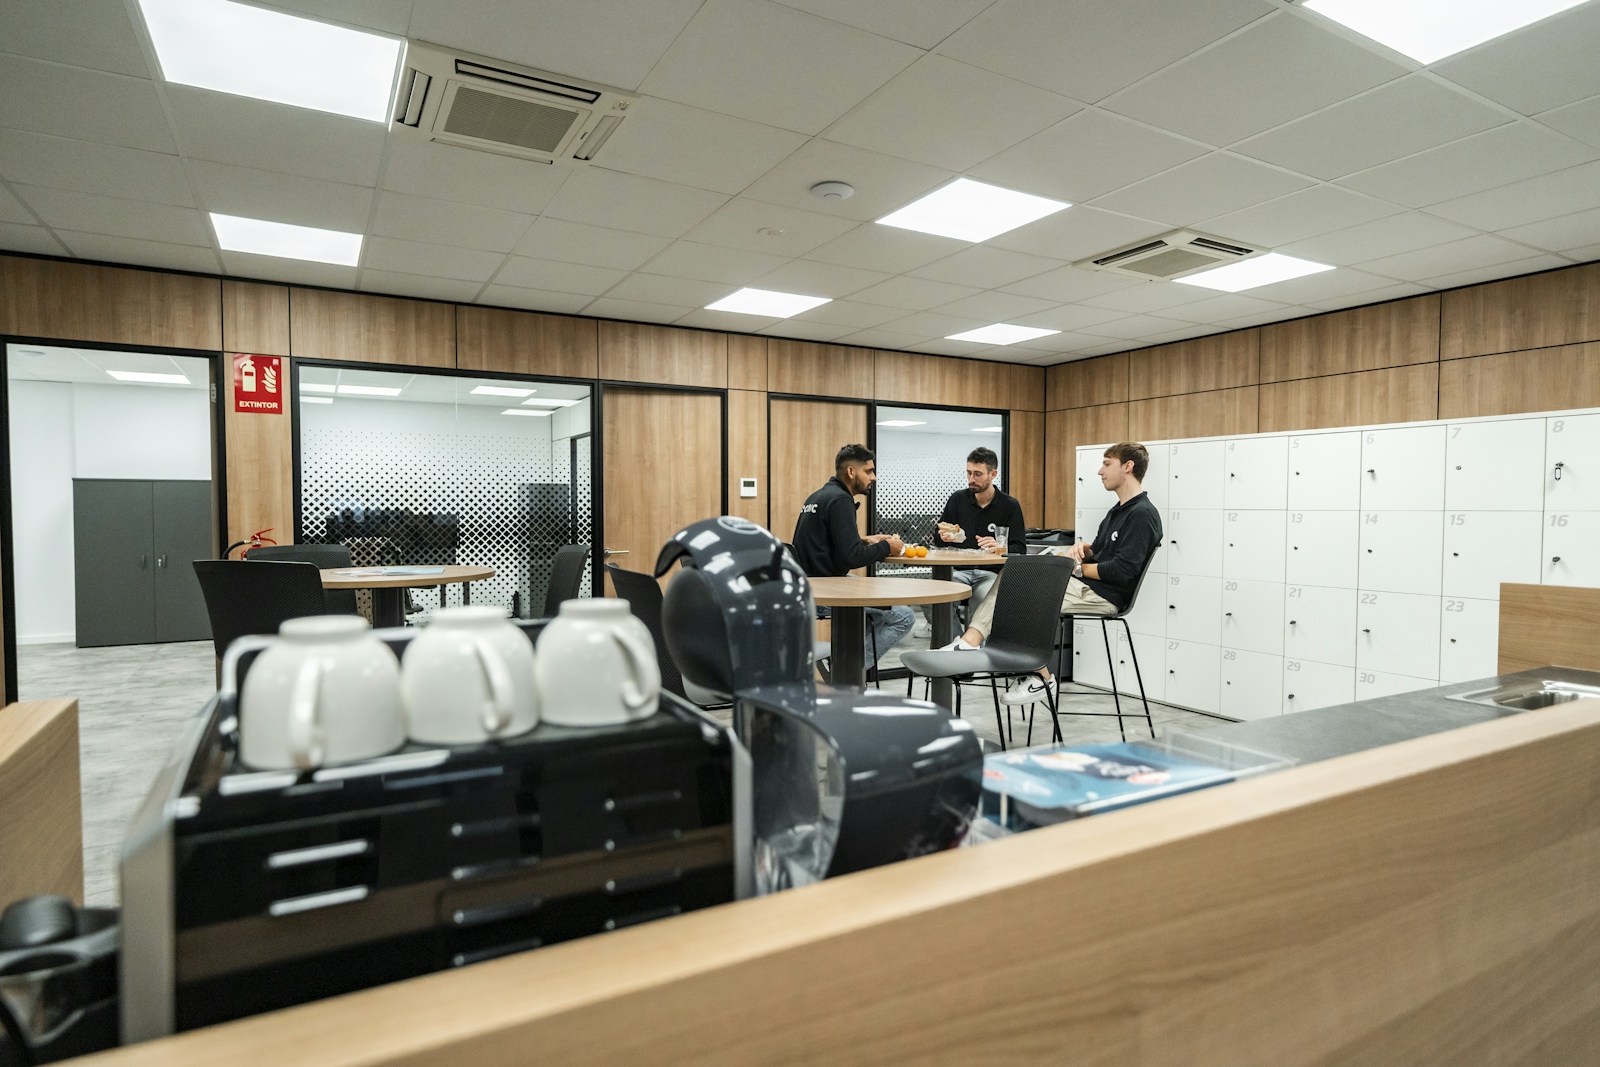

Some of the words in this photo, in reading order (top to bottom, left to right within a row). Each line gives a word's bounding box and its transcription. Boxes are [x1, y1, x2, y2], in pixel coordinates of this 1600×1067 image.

[239, 401, 278, 409] EXTINTOR
[1552, 420, 1564, 433] 8
[1452, 427, 1461, 439] 7
[1366, 433, 1375, 444] 6
[1228, 443, 1235, 452] 4
[1292, 439, 1300, 449] 5
[1172, 446, 1178, 455] 3
[1172, 512, 1180, 520] 11
[1227, 512, 1238, 522] 12
[1291, 513, 1303, 523] 13
[1364, 514, 1378, 524] 14
[1449, 514, 1465, 526] 15
[1550, 515, 1569, 527] 16
[1170, 577, 1179, 585] 19
[1225, 581, 1237, 591] 20
[1289, 588, 1302, 598] 21
[1361, 594, 1377, 605] 22
[1446, 600, 1464, 612] 23
[1075, 626, 1084, 634] 25
[1168, 642, 1179, 650] 27
[1224, 650, 1236, 660] 28
[1287, 660, 1301, 672] 29
[1359, 673, 1376, 684] 30
